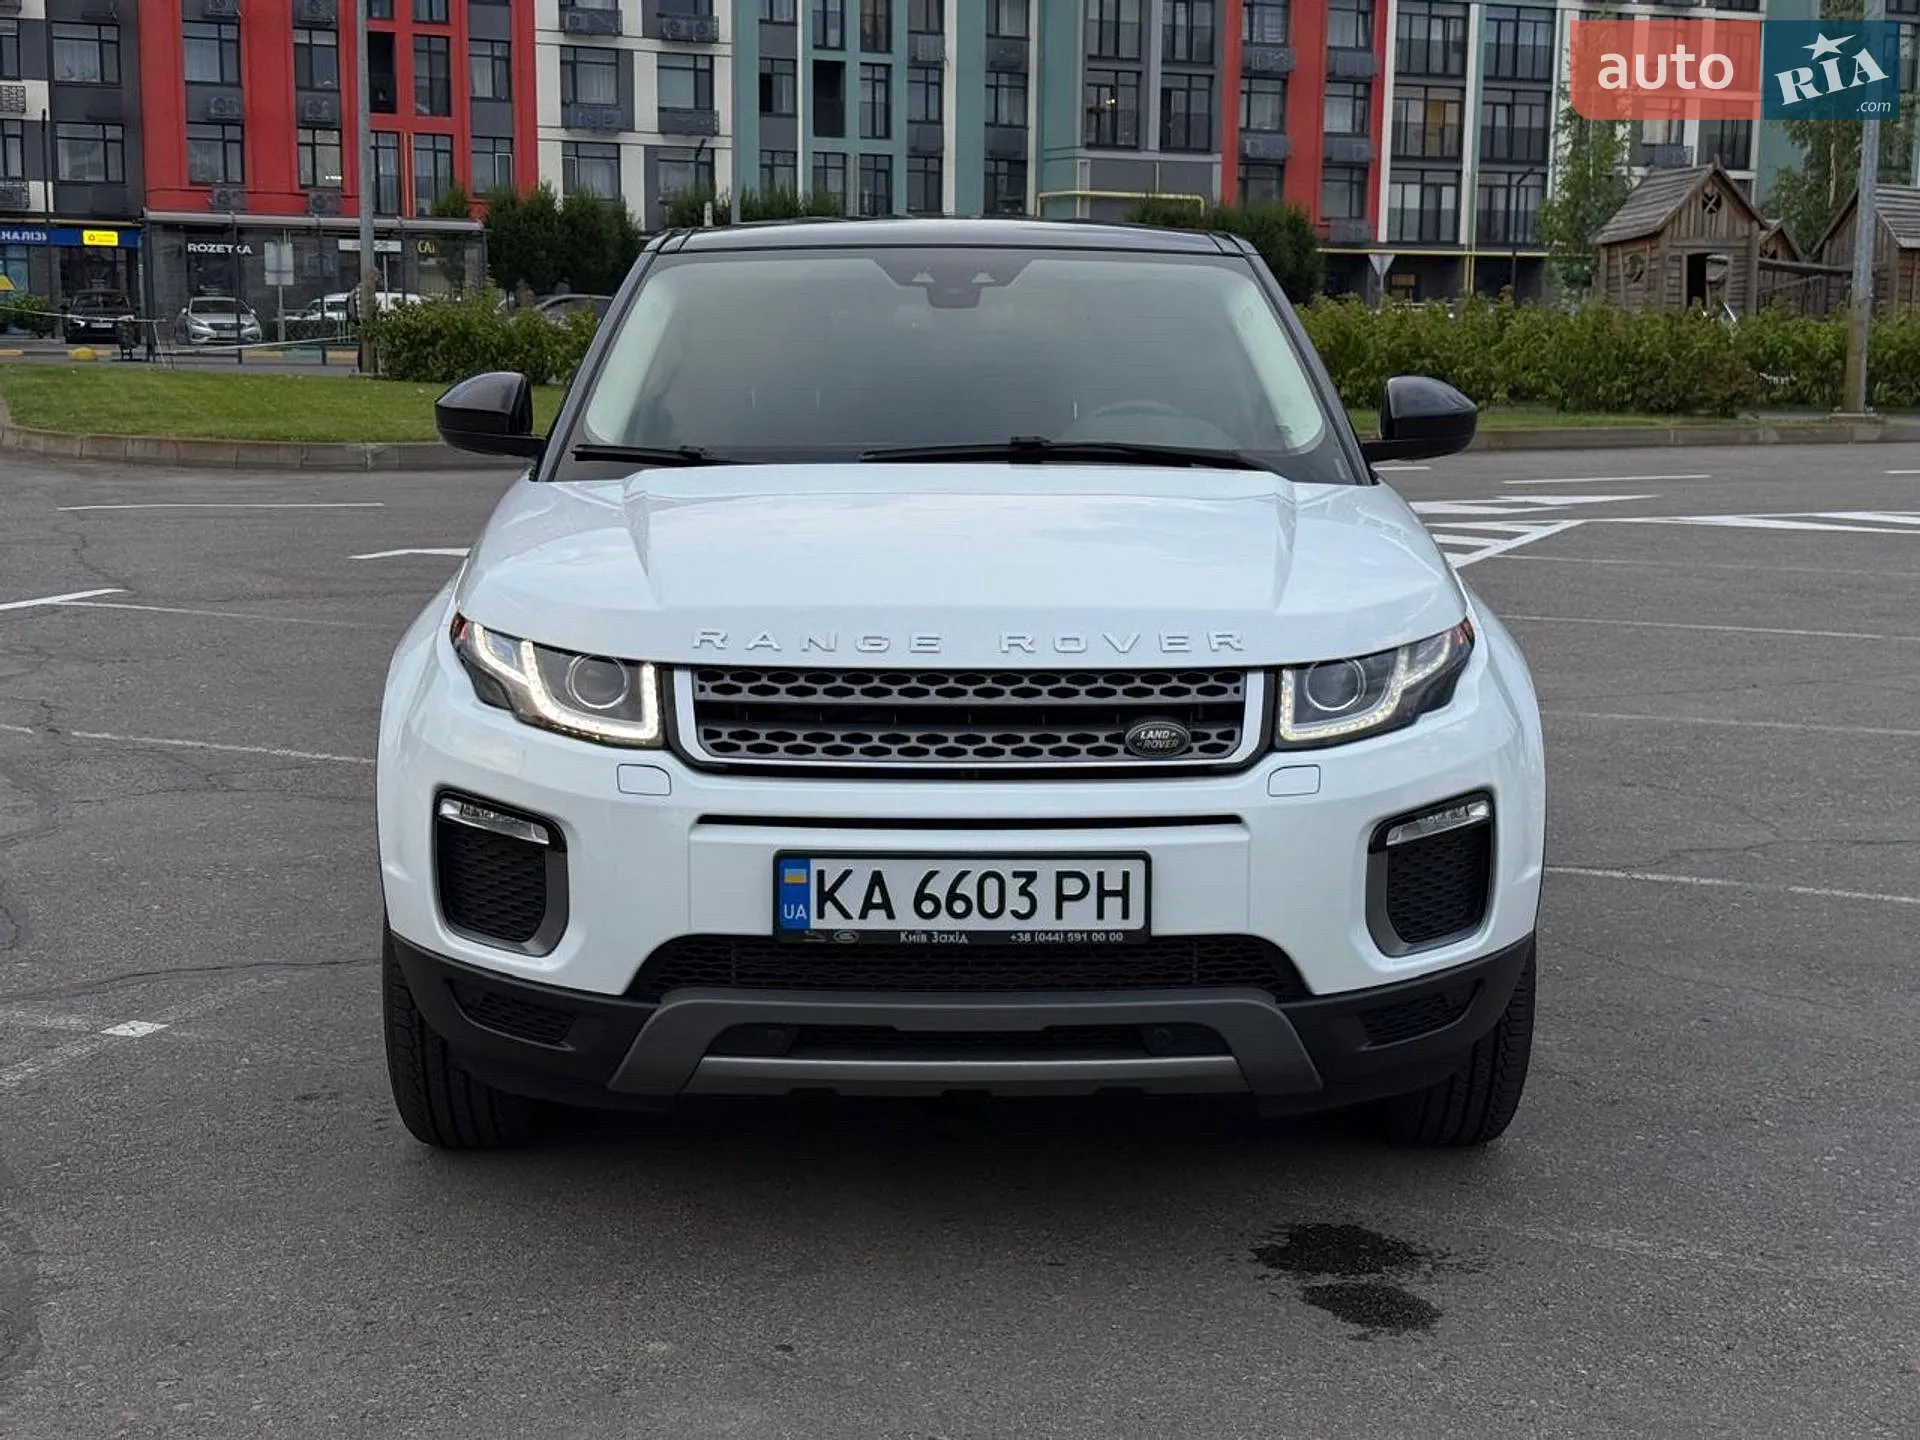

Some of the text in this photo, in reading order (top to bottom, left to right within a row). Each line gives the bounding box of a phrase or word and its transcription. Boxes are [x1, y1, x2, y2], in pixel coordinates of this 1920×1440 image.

[691, 628, 1245, 654] RANGE ROVER
[1140, 730, 1170, 740] LAND
[1143, 739, 1179, 749] ROVER
[815, 868, 1131, 921] KA 6603 PH
[784, 904, 807, 920] UA
[899, 930, 969, 945] Київ Захід
[1010, 932, 1031, 943] +38
[1035, 932, 1063, 944] (044)
[1091, 932, 1106, 943] 00
[1109, 932, 1124, 943] 00
